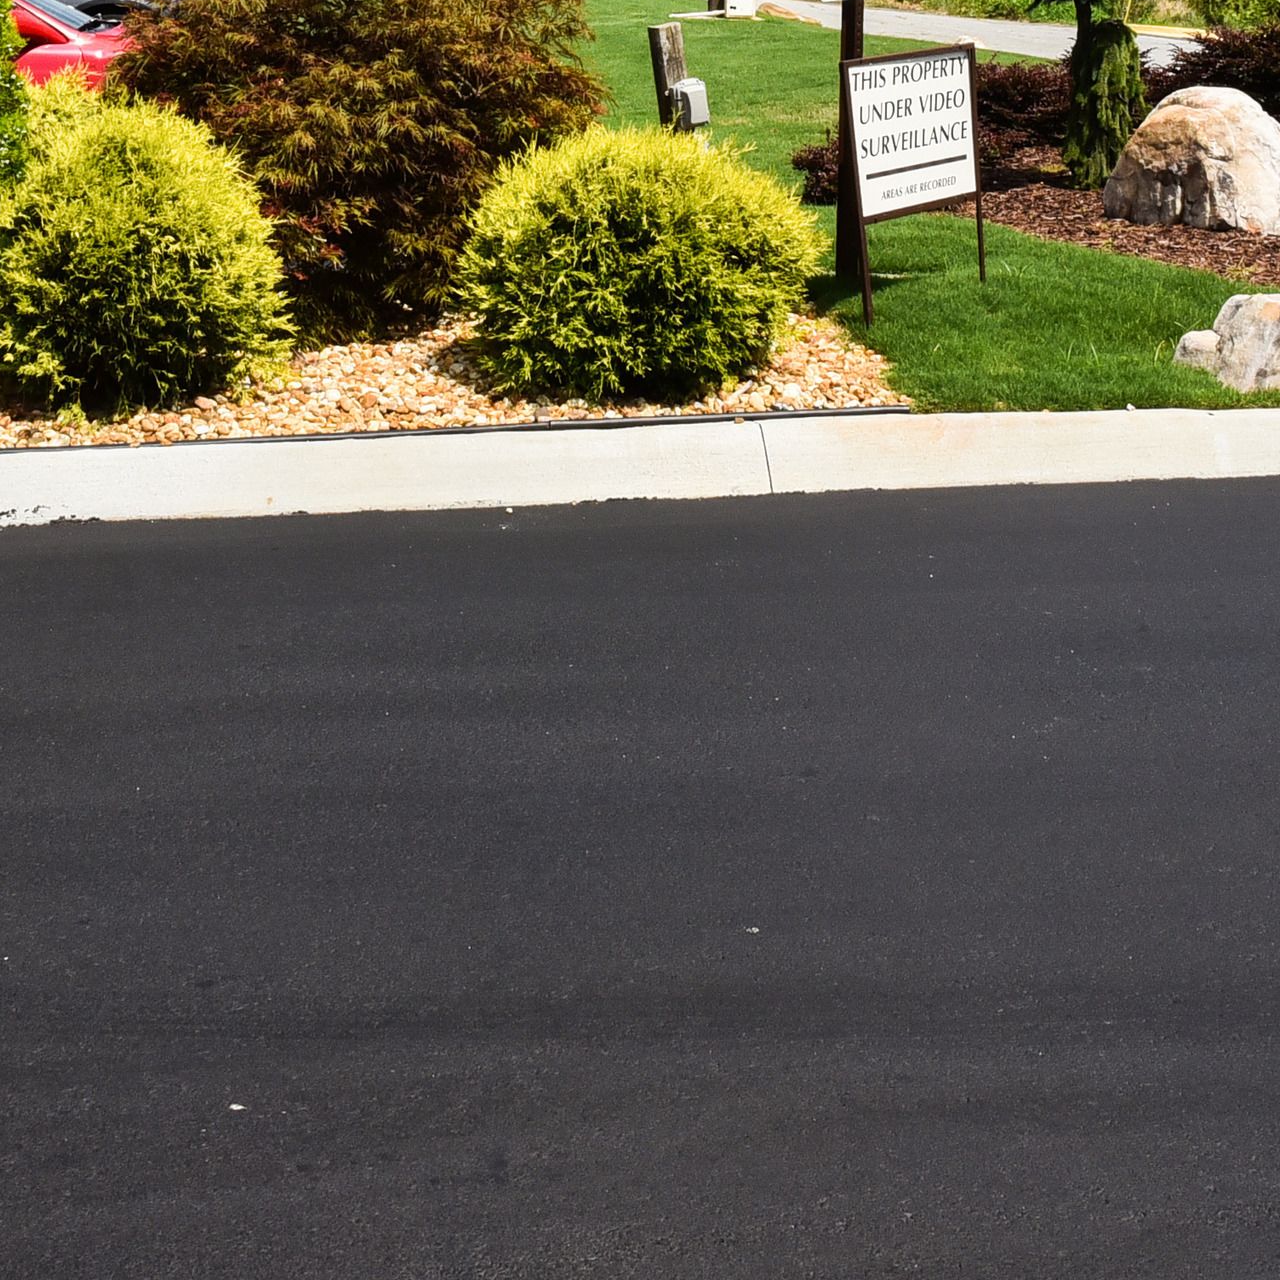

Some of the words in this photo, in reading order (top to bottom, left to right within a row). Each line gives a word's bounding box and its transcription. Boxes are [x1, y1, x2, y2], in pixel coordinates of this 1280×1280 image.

[851, 68, 886, 92] THIS
[892, 56, 967, 86] PROPERTY
[859, 97, 913, 125] UNDER
[919, 88, 965, 114] VIDEO
[860, 120, 968, 160] SURVEILLANCE
[881, 186, 903, 201] AREAS
[905, 183, 918, 195] ARE
[919, 175, 957, 193] RECORDED
